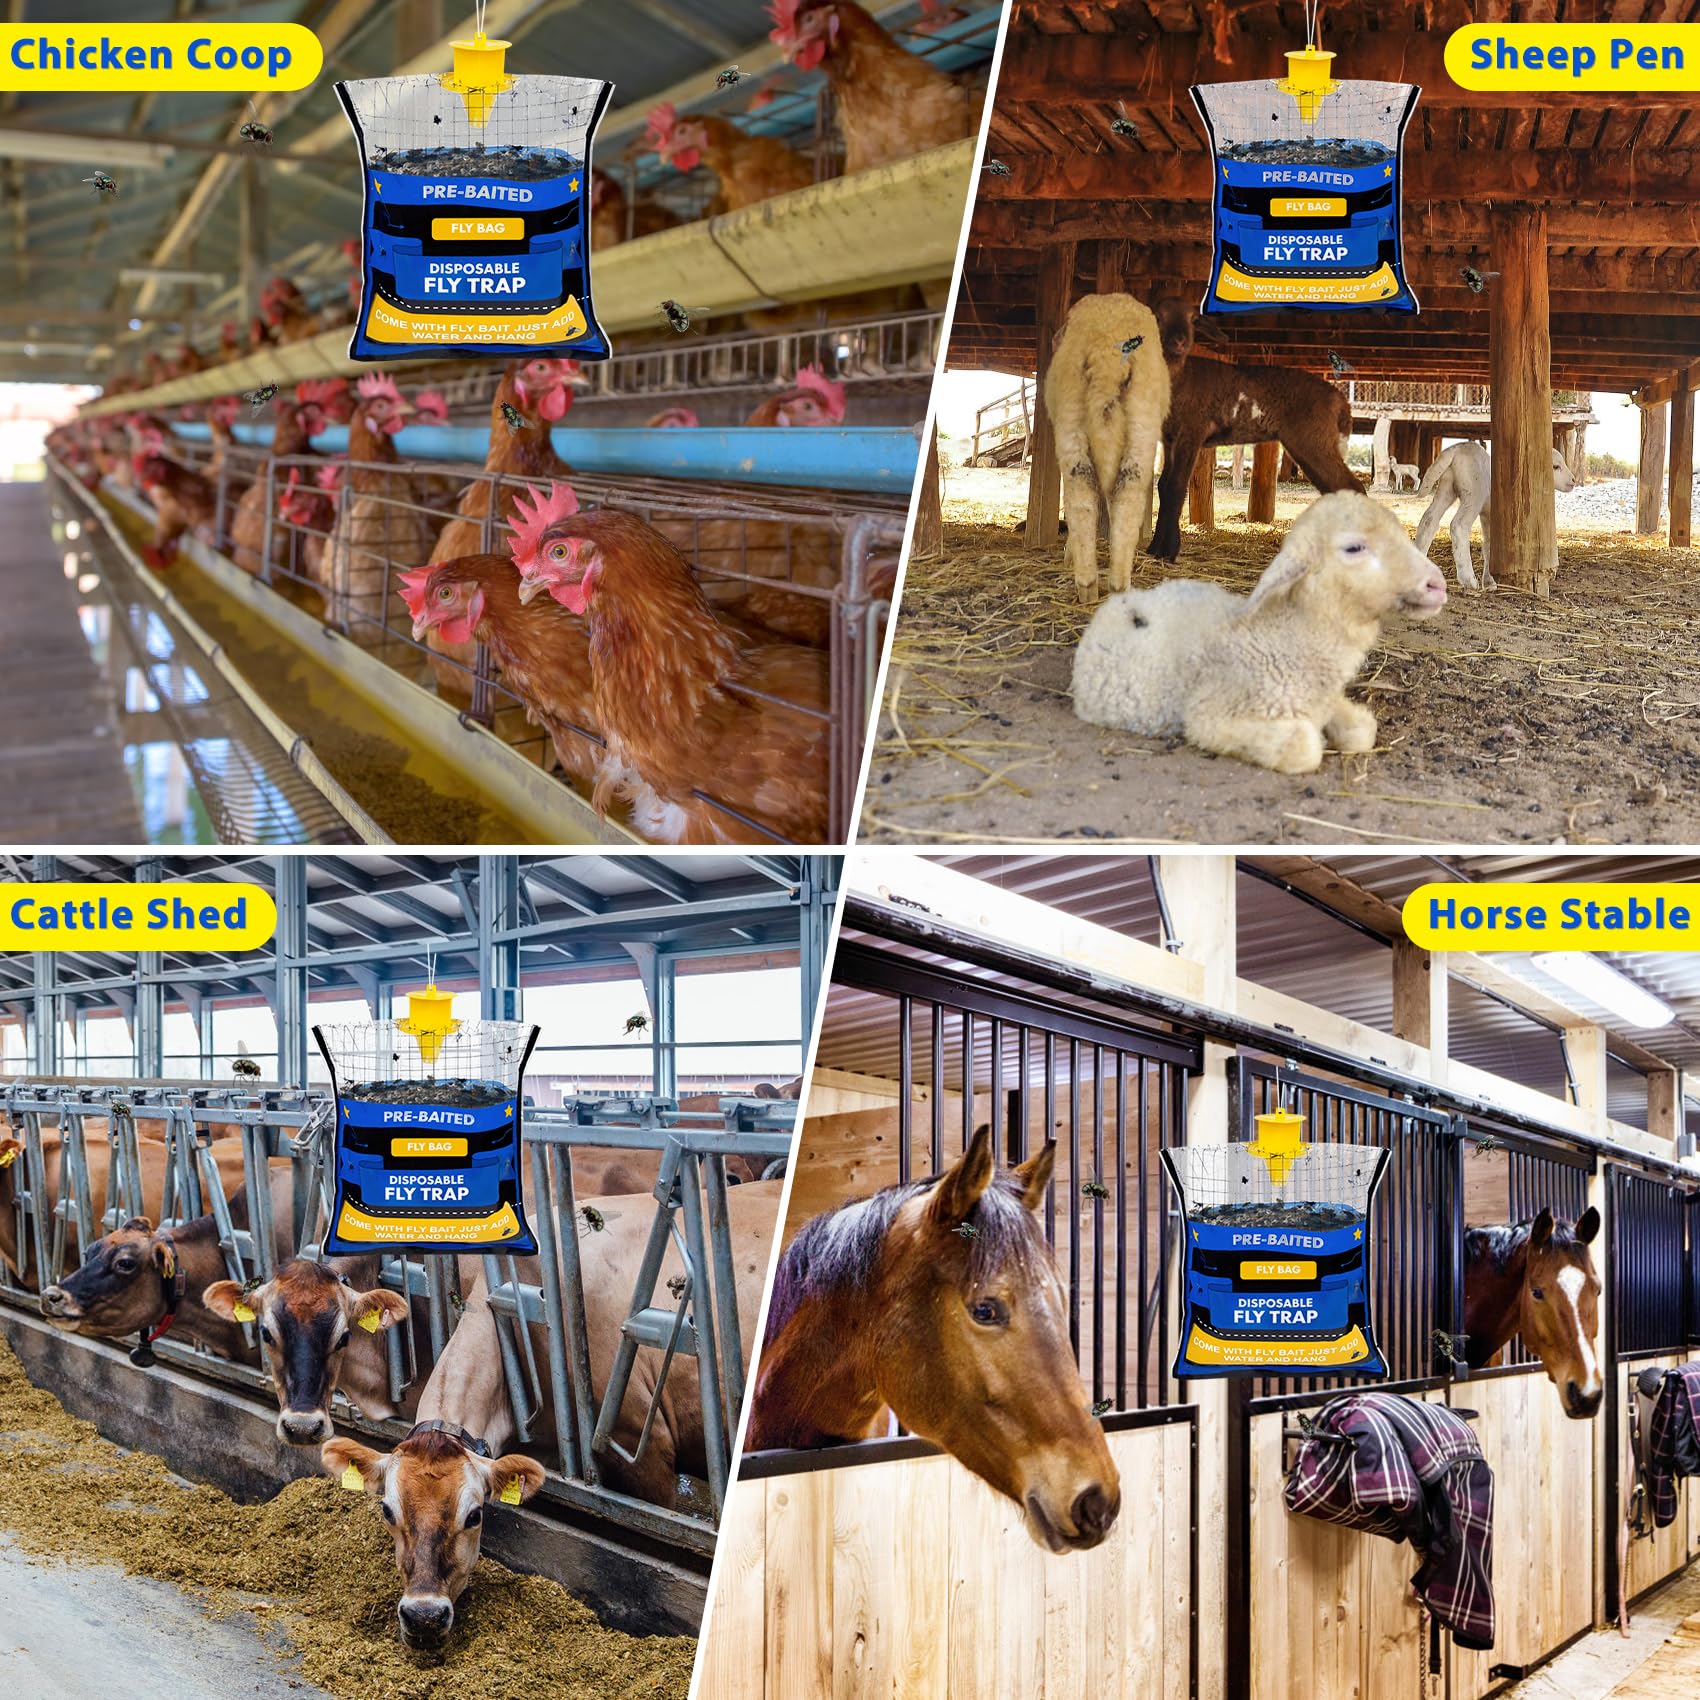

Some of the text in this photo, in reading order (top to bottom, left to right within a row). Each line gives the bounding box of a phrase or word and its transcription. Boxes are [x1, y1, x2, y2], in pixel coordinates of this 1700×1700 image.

[1263, 171, 1354, 186] PRE-BAITED
[423, 185, 532, 203] PRE-BAITED
[1286, 203, 1331, 211] FLY BAG
[452, 223, 505, 233] FLY BAG
[1268, 235, 1343, 245] DISPOSABLE
[1264, 248, 1348, 260] FLY TRAP
[430, 263, 519, 274] DISPOSABLE
[424, 278, 526, 293] FLY TRAP
[1223, 274, 1389, 293] COME WITH FLY BAIT JUST ADD
[375, 309, 574, 332] COME WITH FLY BAIT JUST ADD
[412, 332, 536, 340] WATER AND HANG
[384, 1111, 475, 1126] PRE-BAITED
[407, 1143, 452, 1151] FLY BAG
[389, 1175, 464, 1185] DISPOSABLE
[385, 1188, 469, 1200] FLY TRAP
[344, 1214, 510, 1233] COME WITH FLY BAIT JUST ADD
[1233, 1234, 1324, 1249] PRE-BAITED
[1256, 1266, 1301, 1274] FLY BAG
[1238, 1298, 1313, 1308] DISPOSABLE
[1234, 1311, 1318, 1323] FLY TRAP
[1193, 1337, 1359, 1356] COME WITH FLY BAIT JUST ADD
